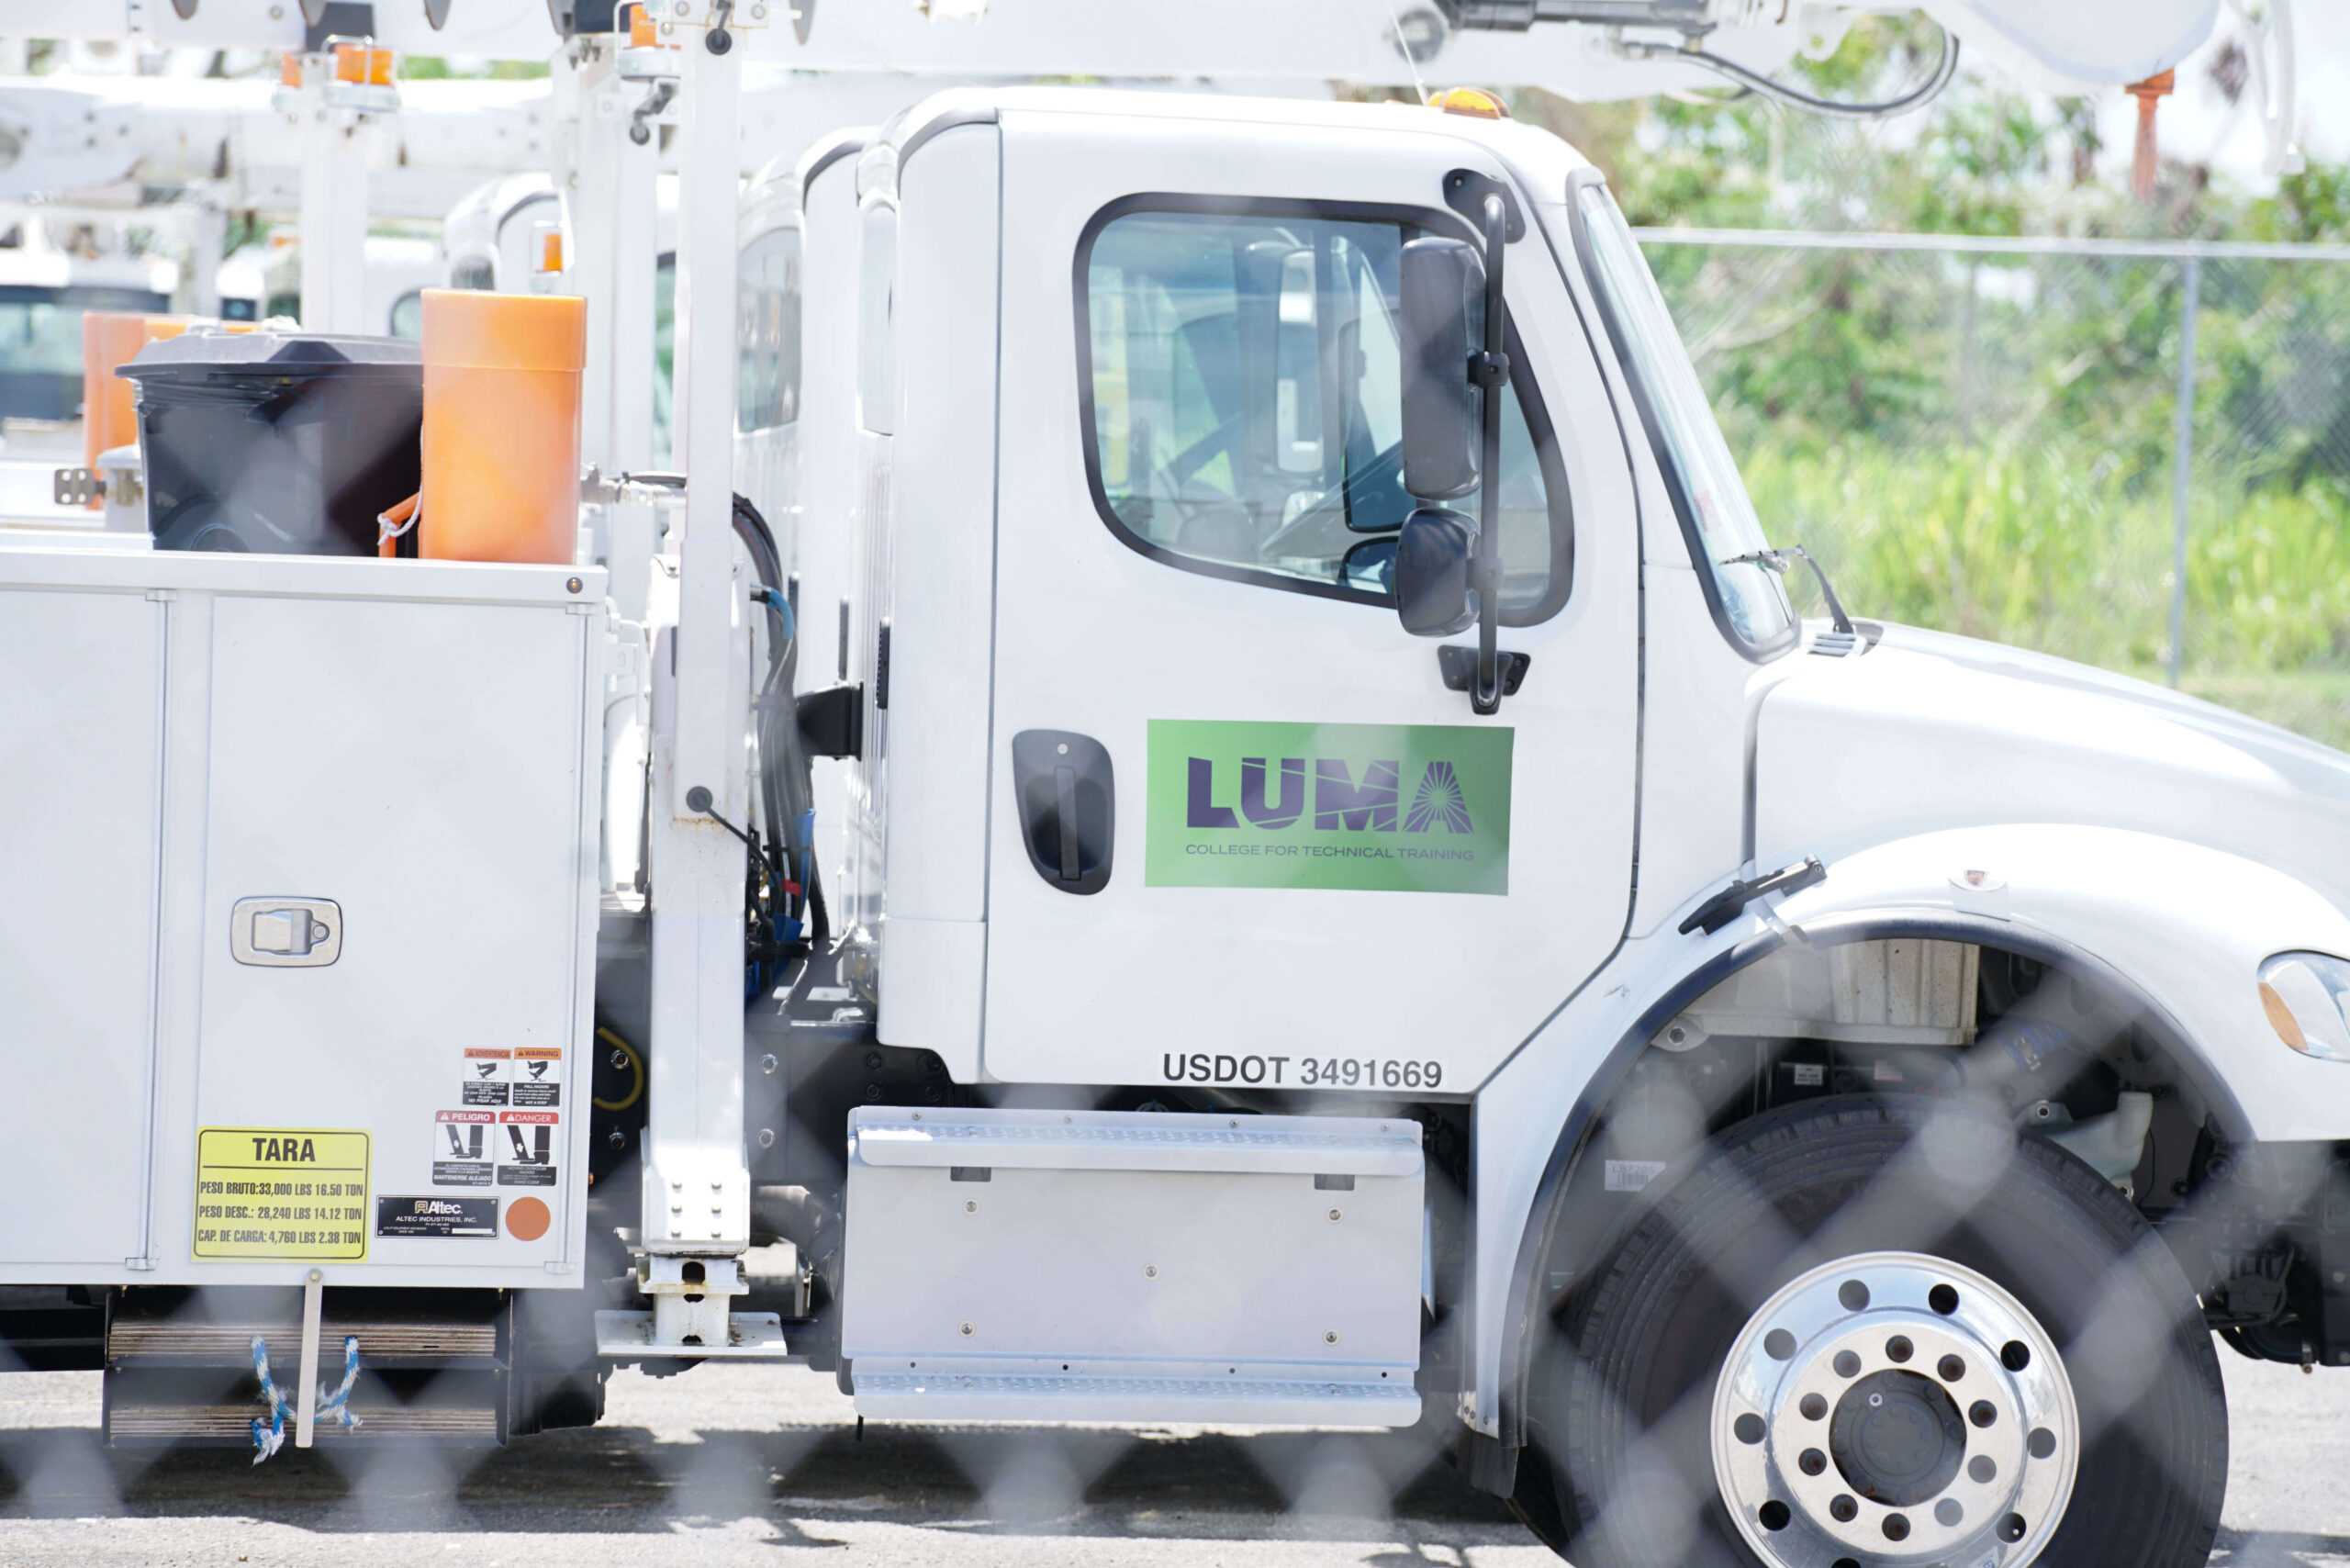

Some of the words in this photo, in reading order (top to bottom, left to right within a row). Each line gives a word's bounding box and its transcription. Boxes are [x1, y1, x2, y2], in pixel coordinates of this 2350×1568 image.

[1187, 756, 1474, 834] LUMA
[1186, 844, 1260, 856] COLLEGE
[1265, 846, 1298, 857] FOR
[1303, 846, 1394, 859] TECHNICAL
[1397, 847, 1475, 861] TRAINING
[525, 1049, 559, 1058] WARNING
[1163, 1053, 1290, 1084] USDOT
[1300, 1058, 1442, 1089] 3491669
[452, 1113, 491, 1121] PELIGRO
[515, 1114, 552, 1123] DANGER
[252, 1137, 316, 1162] TARA
[200, 1181, 223, 1194] PESO
[295, 1183, 312, 1196] LBS
[315, 1183, 341, 1196] 16.50
[345, 1183, 364, 1197] TON
[199, 1205, 222, 1218] PESO
[257, 1206, 291, 1221] 28,240
[294, 1207, 311, 1220] LBS
[314, 1207, 341, 1220] 14.12
[344, 1207, 363, 1220] TON
[197, 1229, 217, 1242] CAP.
[219, 1229, 231, 1242] DE
[234, 1229, 267, 1243] CARGA:
[269, 1230, 296, 1245] 4,760
[298, 1231, 316, 1244] LBS
[319, 1231, 340, 1244] 2.38
[343, 1231, 361, 1244] TON
